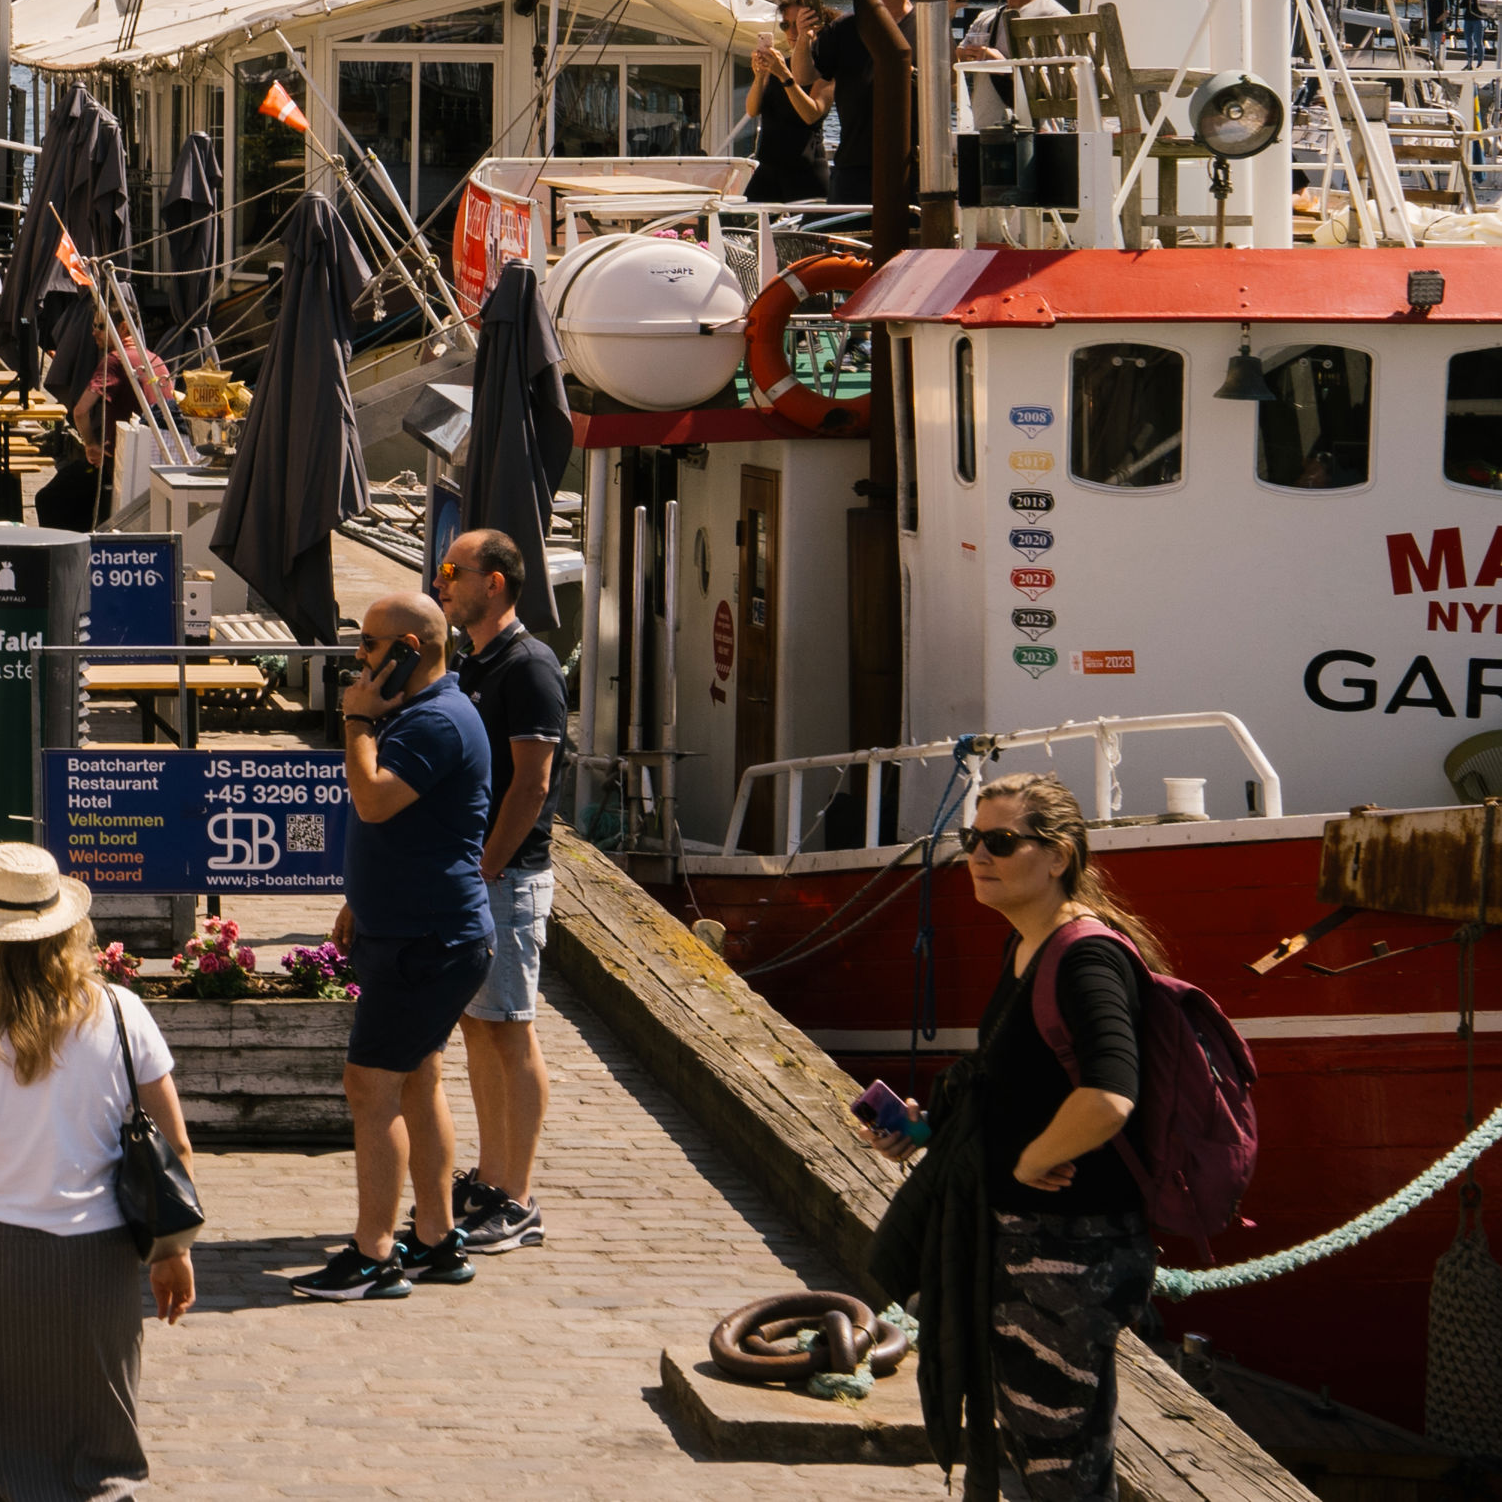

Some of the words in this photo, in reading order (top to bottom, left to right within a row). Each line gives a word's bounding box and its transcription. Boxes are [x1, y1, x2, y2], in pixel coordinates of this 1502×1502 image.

[193, 387, 221, 403] CHIPS
[1016, 411, 1047, 424] 2008
[1016, 455, 1046, 468] 2017
[1016, 496, 1046, 508] 2018
[1017, 534, 1047, 546] 2020
[109, 570, 157, 587] 9016
[1018, 573, 1048, 585] 2021
[1019, 613, 1049, 626] 2022
[1021, 651, 1050, 664] 2023
[1105, 656, 1133, 669] 2023
[68, 758, 166, 773] Boatcharter
[68, 776, 159, 791] Restaurant
[204, 784, 246, 804] +45
[252, 785, 308, 804] 3296
[68, 794, 112, 809] Hotel
[68, 813, 165, 827] Velkommen
[69, 834, 95, 845] om
[100, 831, 137, 845] bord
[69, 850, 144, 864] Welcome
[69, 871, 90, 882] on
[95, 868, 143, 882] board
